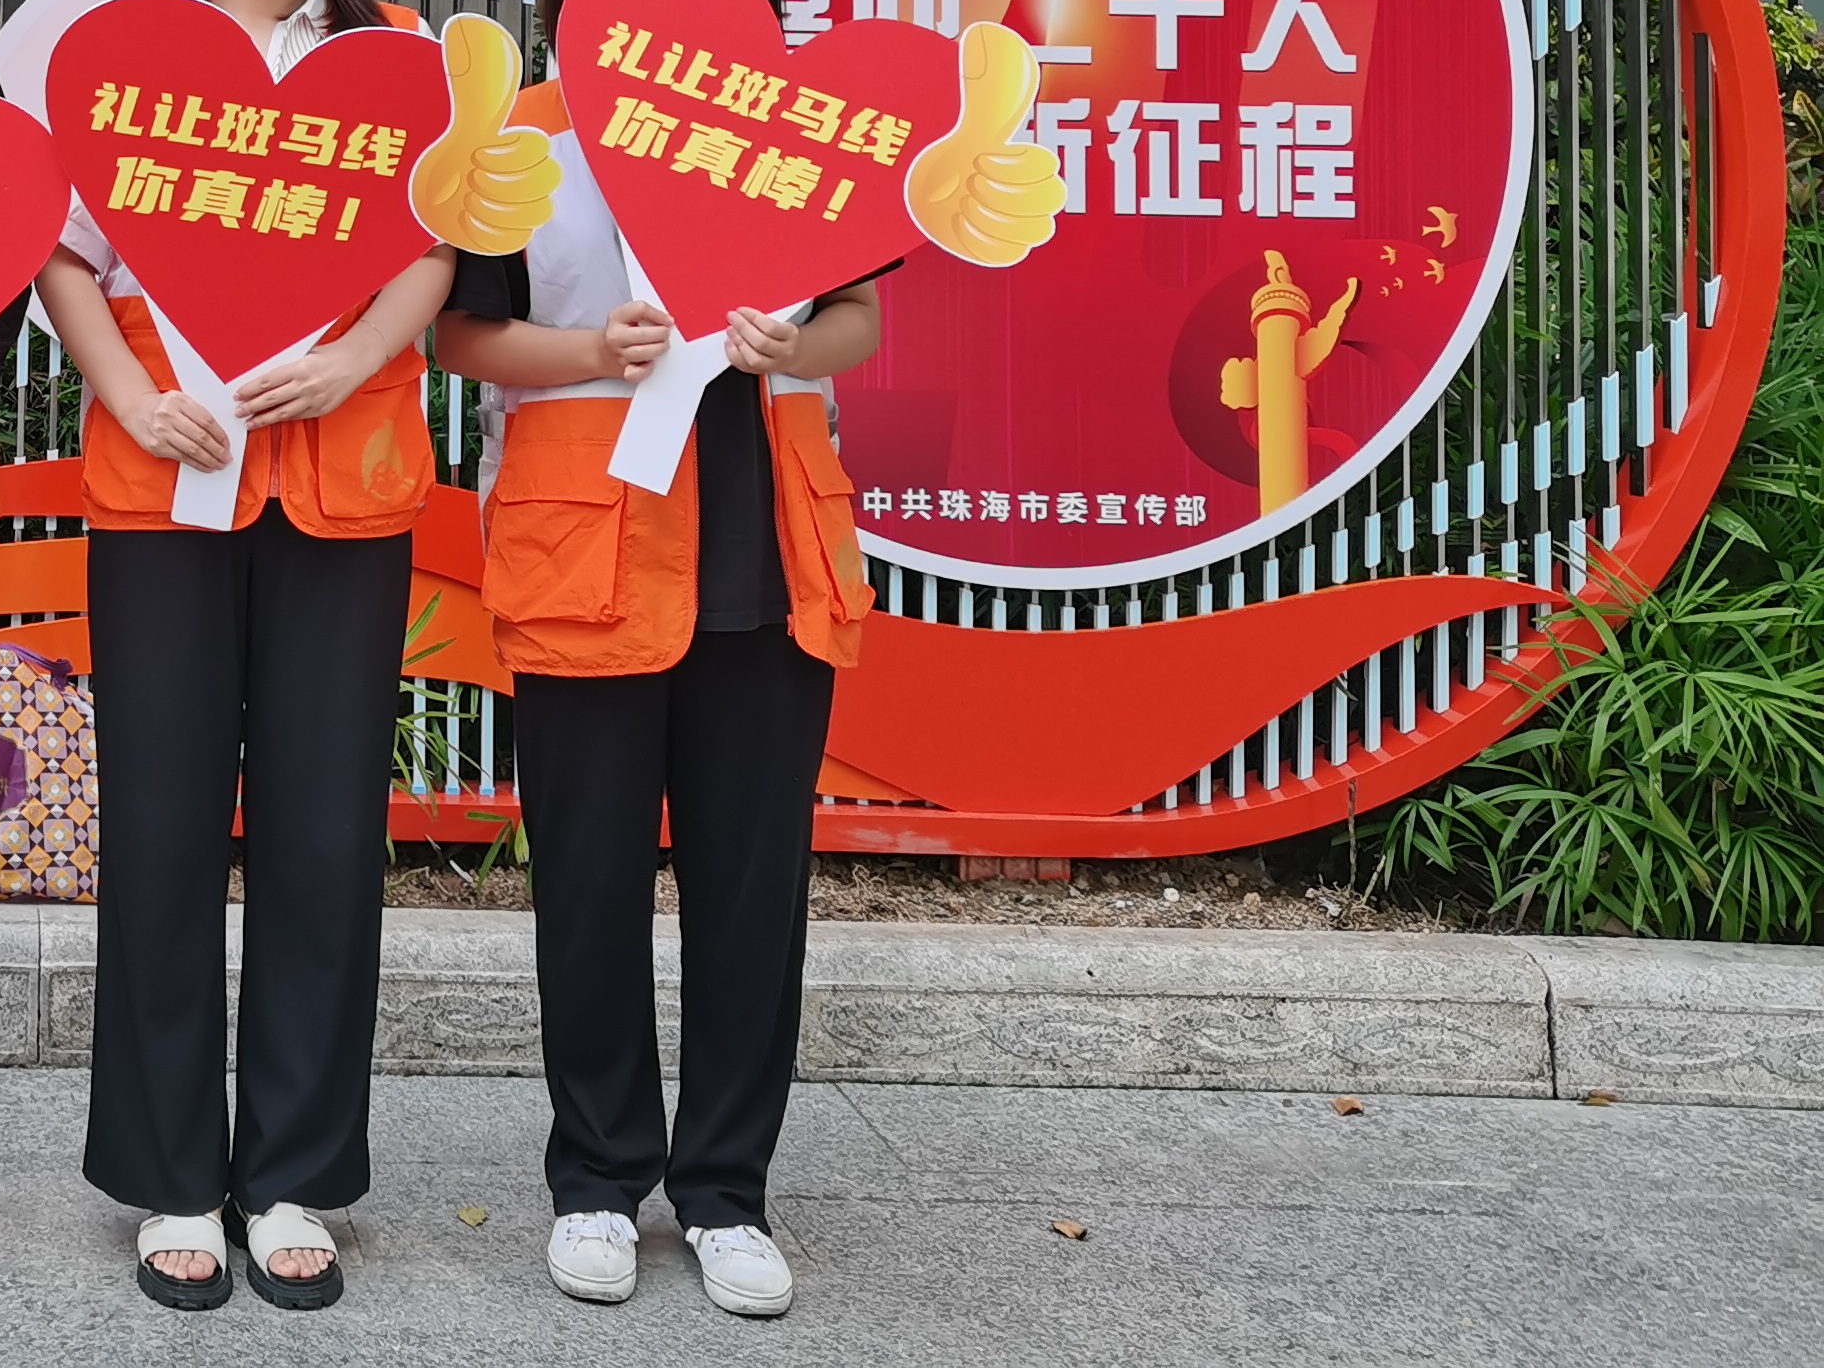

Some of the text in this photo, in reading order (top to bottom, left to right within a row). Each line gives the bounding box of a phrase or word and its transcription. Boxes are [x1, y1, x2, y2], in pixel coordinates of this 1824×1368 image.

[89, 82, 408, 178] 礼让斑马线
[597, 21, 913, 167] 礼让斑马线
[106, 156, 362, 242] 你真棒！
[599, 96, 856, 222] 你真棒！
[862, 486, 1208, 527] 中共珠海市委宣传部
